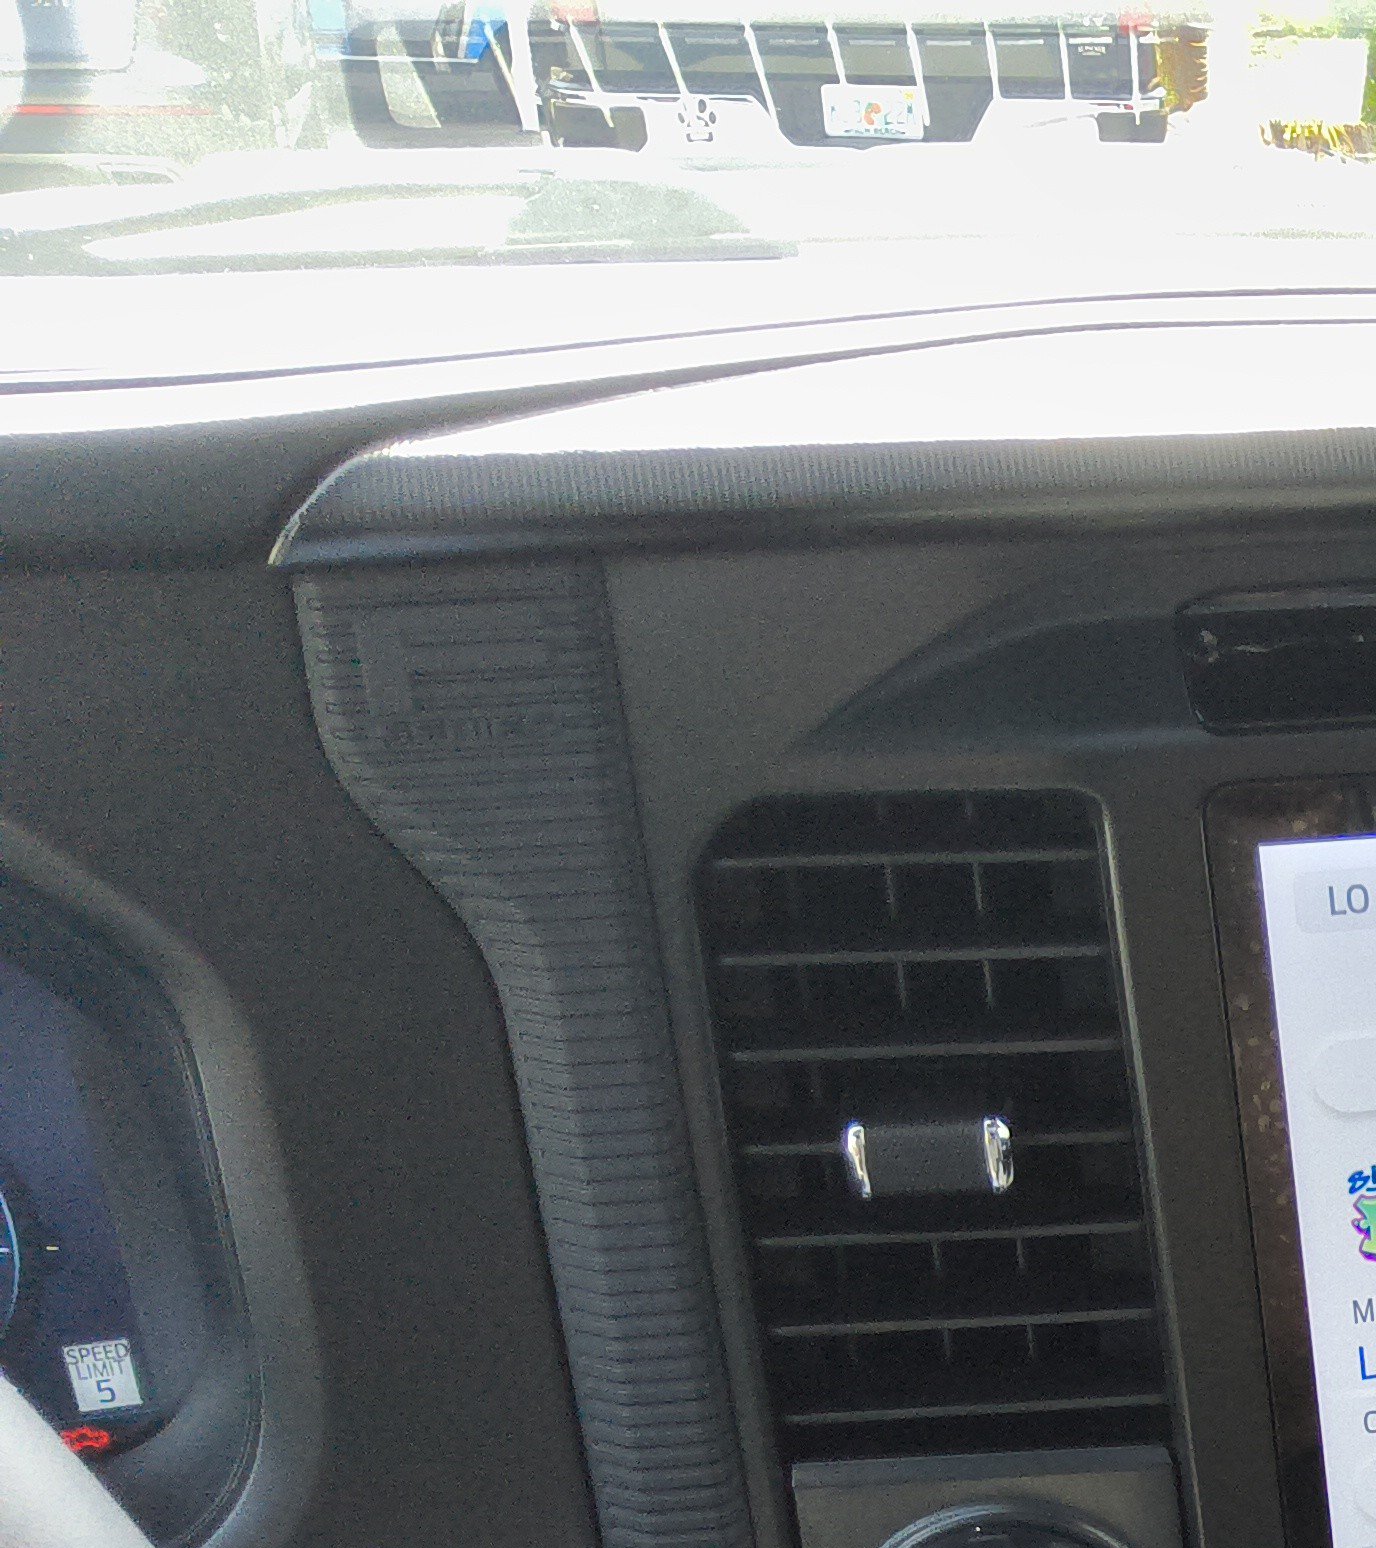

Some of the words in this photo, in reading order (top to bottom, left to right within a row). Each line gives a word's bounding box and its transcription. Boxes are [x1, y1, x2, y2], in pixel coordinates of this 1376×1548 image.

[1328, 883, 1370, 916] LO
[66, 1342, 130, 1366] SPEED
[75, 1359, 126, 1378] LIMIT
[96, 1379, 115, 1403] 5
